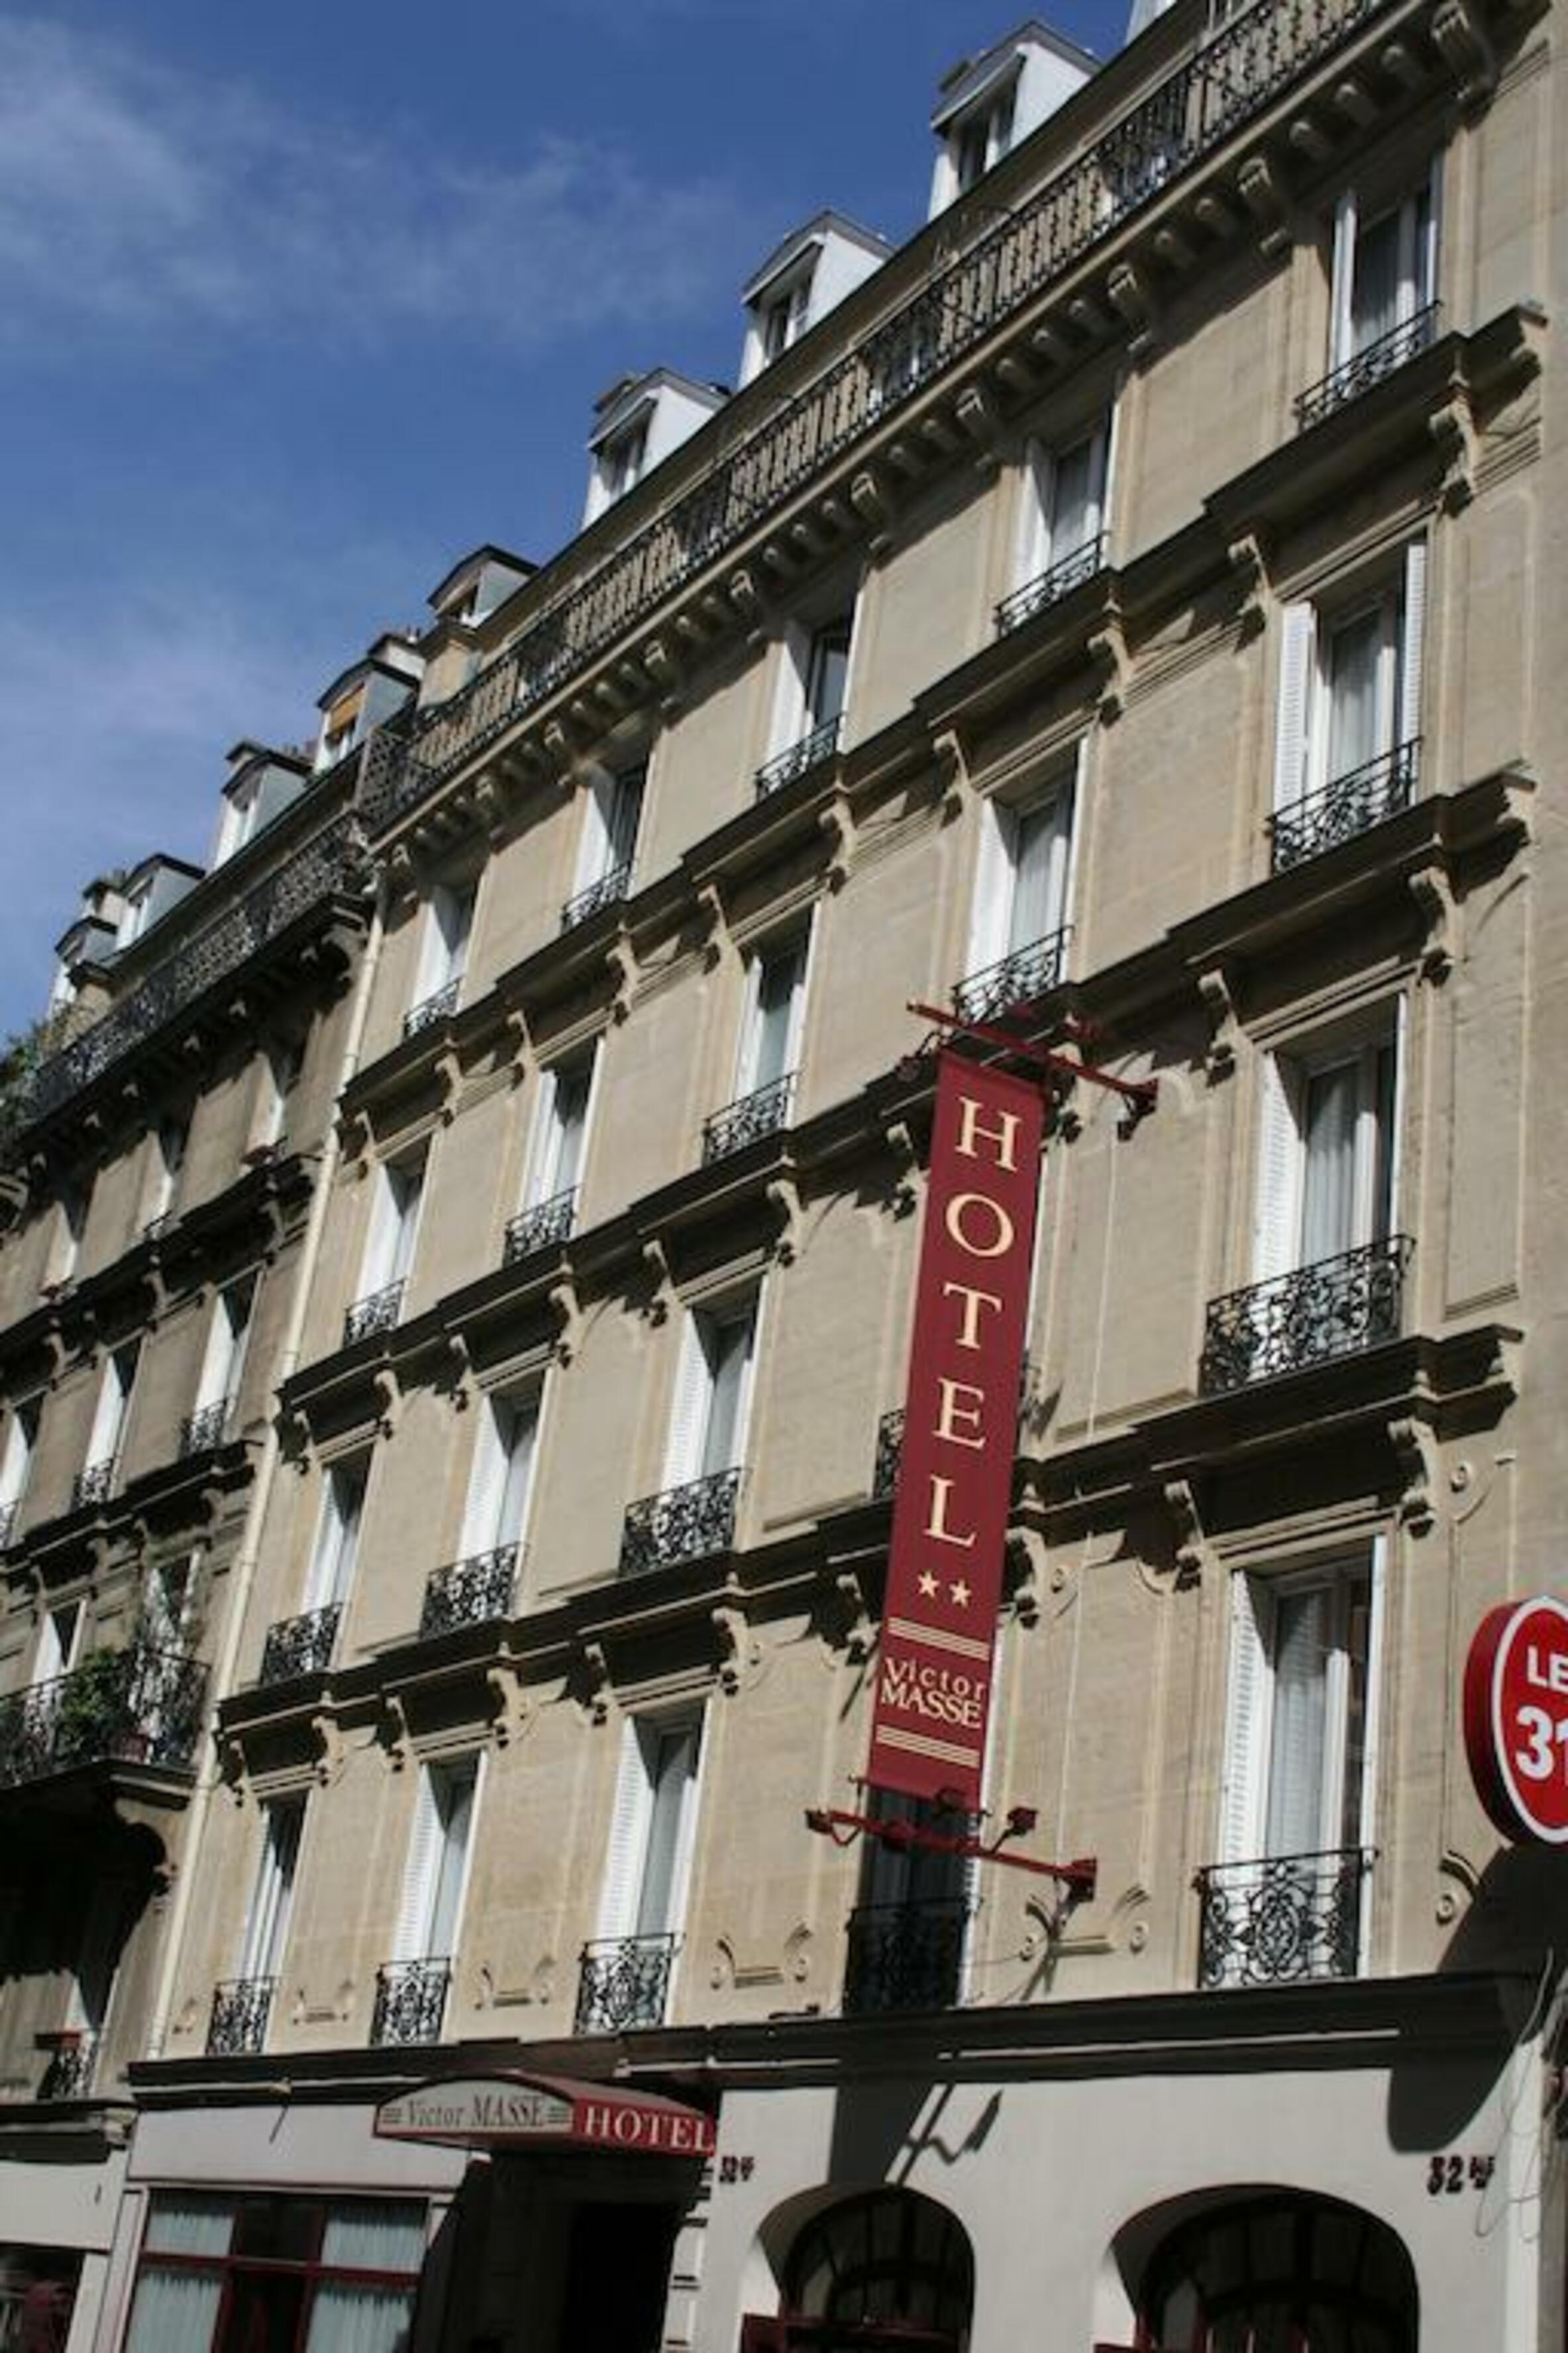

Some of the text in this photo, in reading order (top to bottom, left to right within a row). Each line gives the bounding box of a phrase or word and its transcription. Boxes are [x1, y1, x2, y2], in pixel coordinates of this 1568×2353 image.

[923, 1096, 1021, 1547] HOTEL
[885, 1657, 986, 1700] Victor
[1526, 1645, 1568, 1694] LE
[881, 1678, 981, 1729] MASSE
[406, 2095, 545, 2126] Victor MASSE
[586, 2106, 715, 2152] HOTEL
